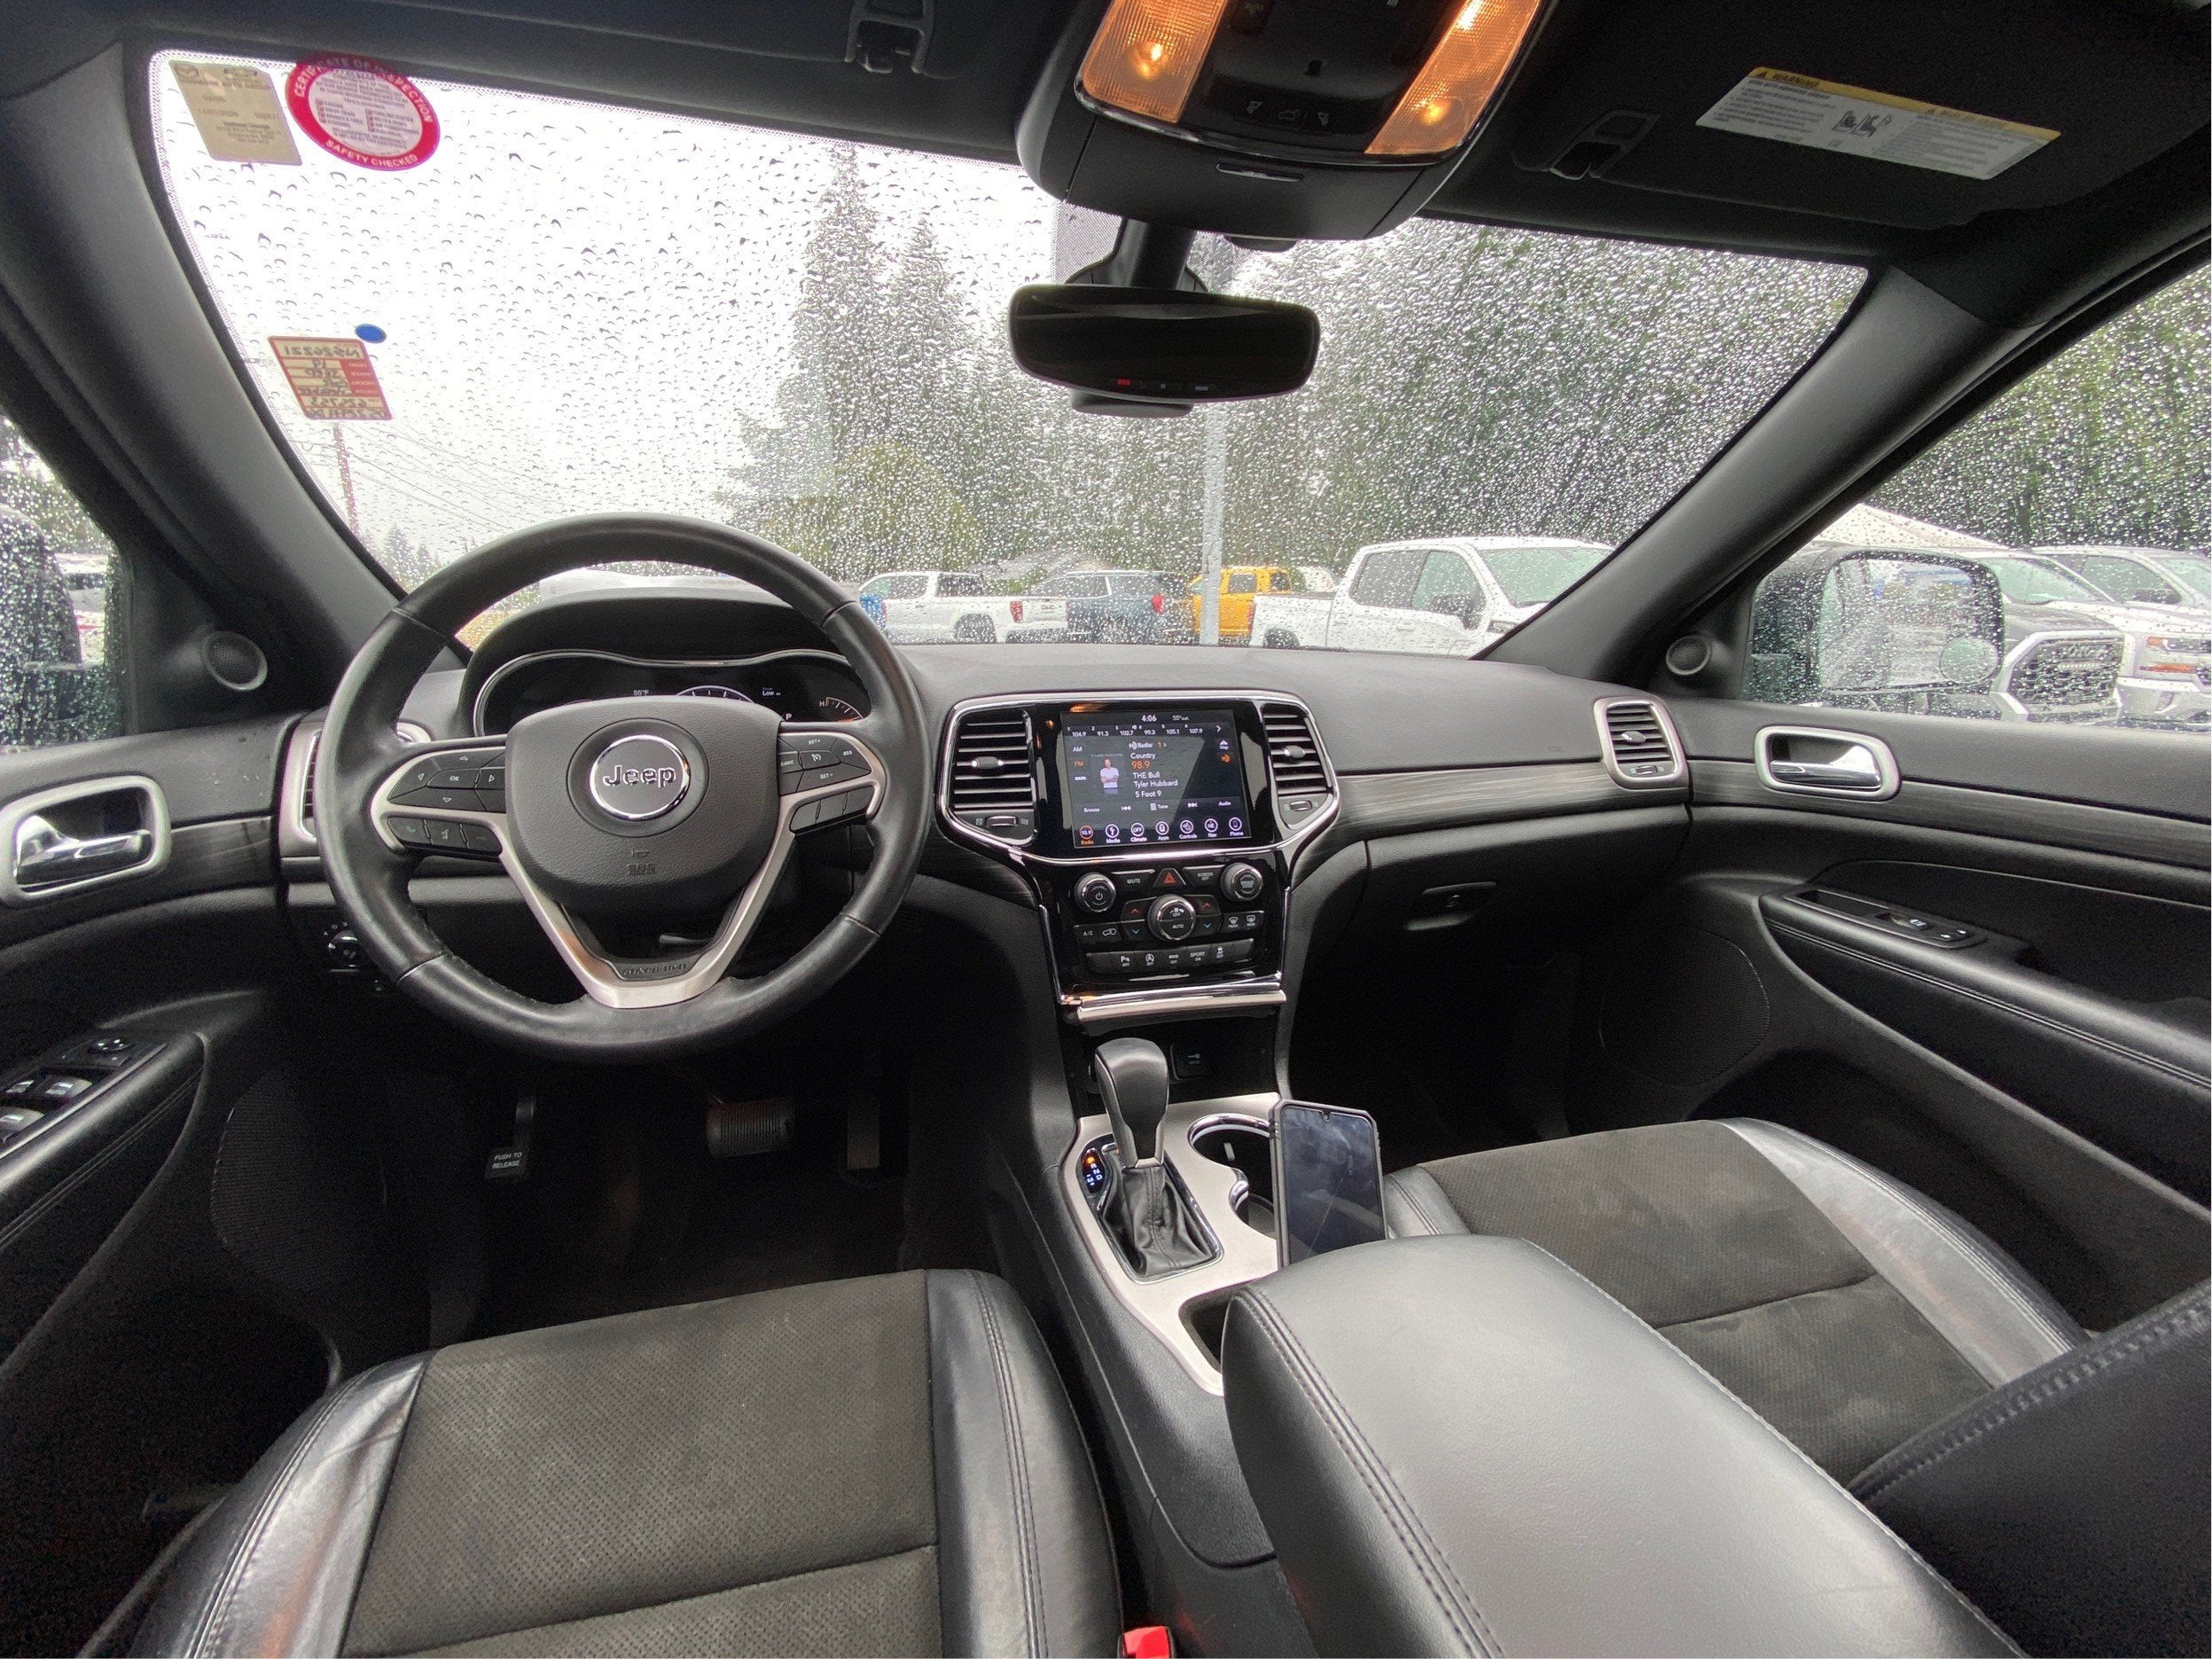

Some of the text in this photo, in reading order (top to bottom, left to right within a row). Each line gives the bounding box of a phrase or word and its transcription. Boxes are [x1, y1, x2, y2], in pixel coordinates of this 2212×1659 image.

[325, 140, 418, 168] SAFETY CHECKED
[1141, 714, 1157, 723] 4:06
[1131, 760, 1151, 770] 98.9
[602, 764, 676, 789] Jeep
[1150, 779, 1178, 787] Hubbard
[492, 1160, 520, 1169] RELEASE
